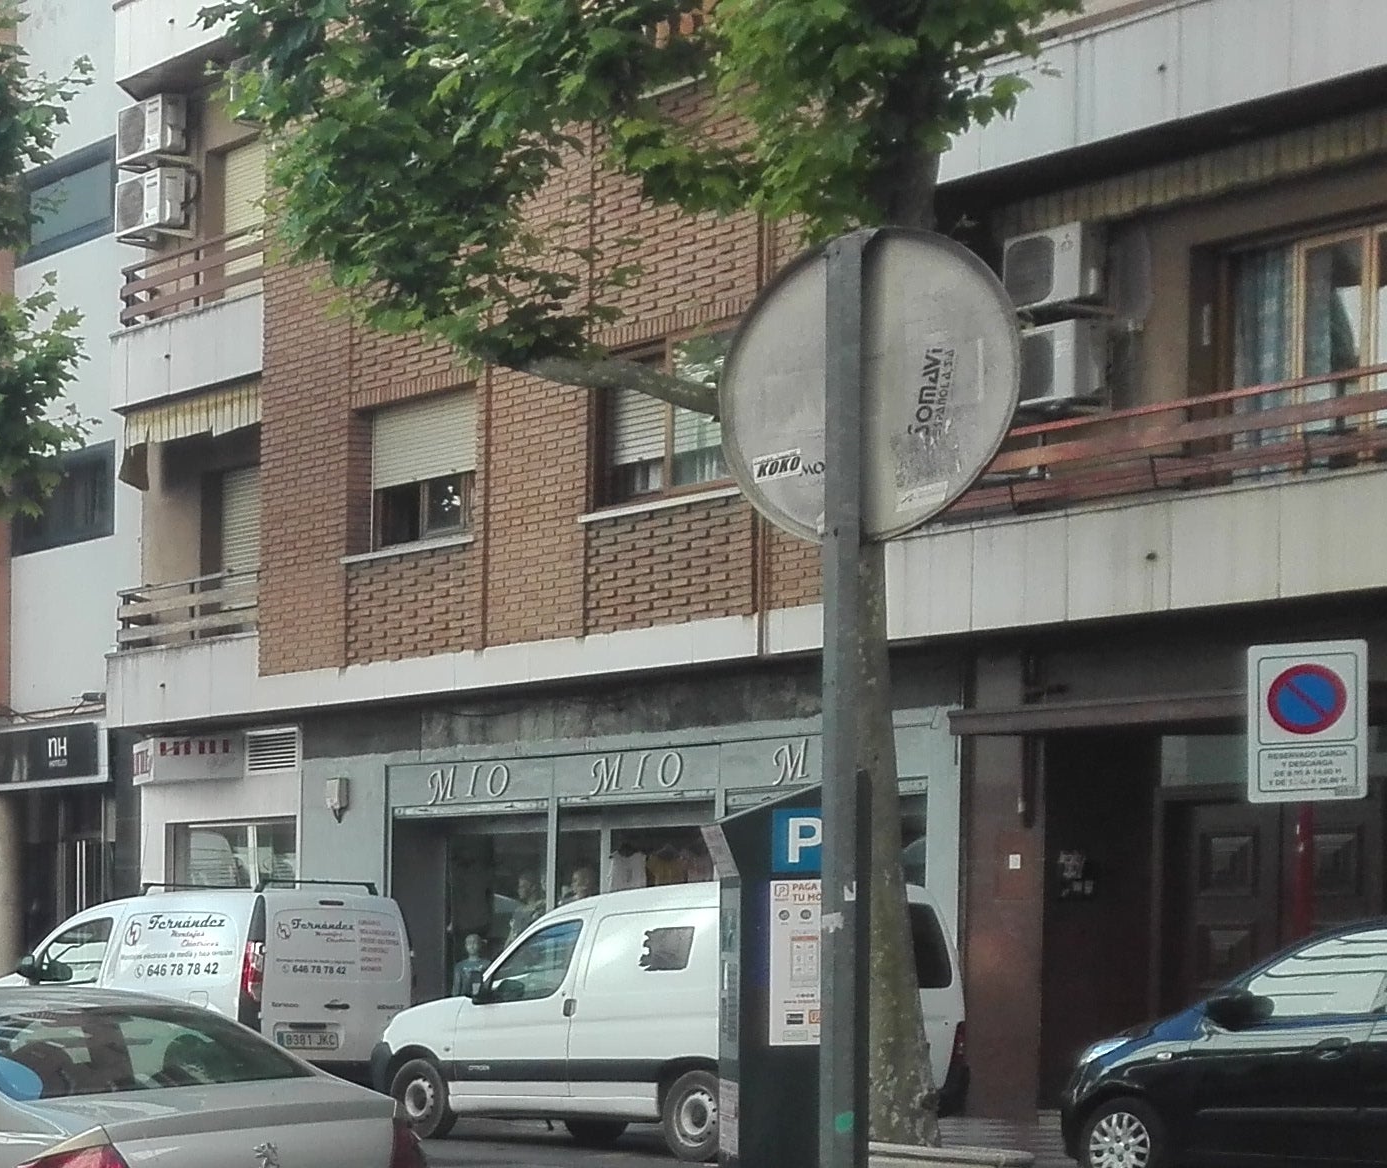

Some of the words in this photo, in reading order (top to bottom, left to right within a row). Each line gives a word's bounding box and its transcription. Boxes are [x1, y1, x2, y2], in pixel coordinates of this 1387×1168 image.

[756, 456, 801, 478] KOKO
[590, 751, 684, 796] MIO
[427, 762, 511, 806] MIO
[788, 816, 822, 864] P
[792, 883, 818, 892] PAGA
[793, 894, 805, 902] TU
[147, 914, 226, 930] Fernández
[146, 963, 168, 978] 646
[170, 963, 184, 976] 78
[187, 962, 201, 976] 78
[203, 961, 220, 976] 42
[311, 965, 322, 974] 78
[324, 965, 335, 975] 78
[336, 966, 347, 975] 42
